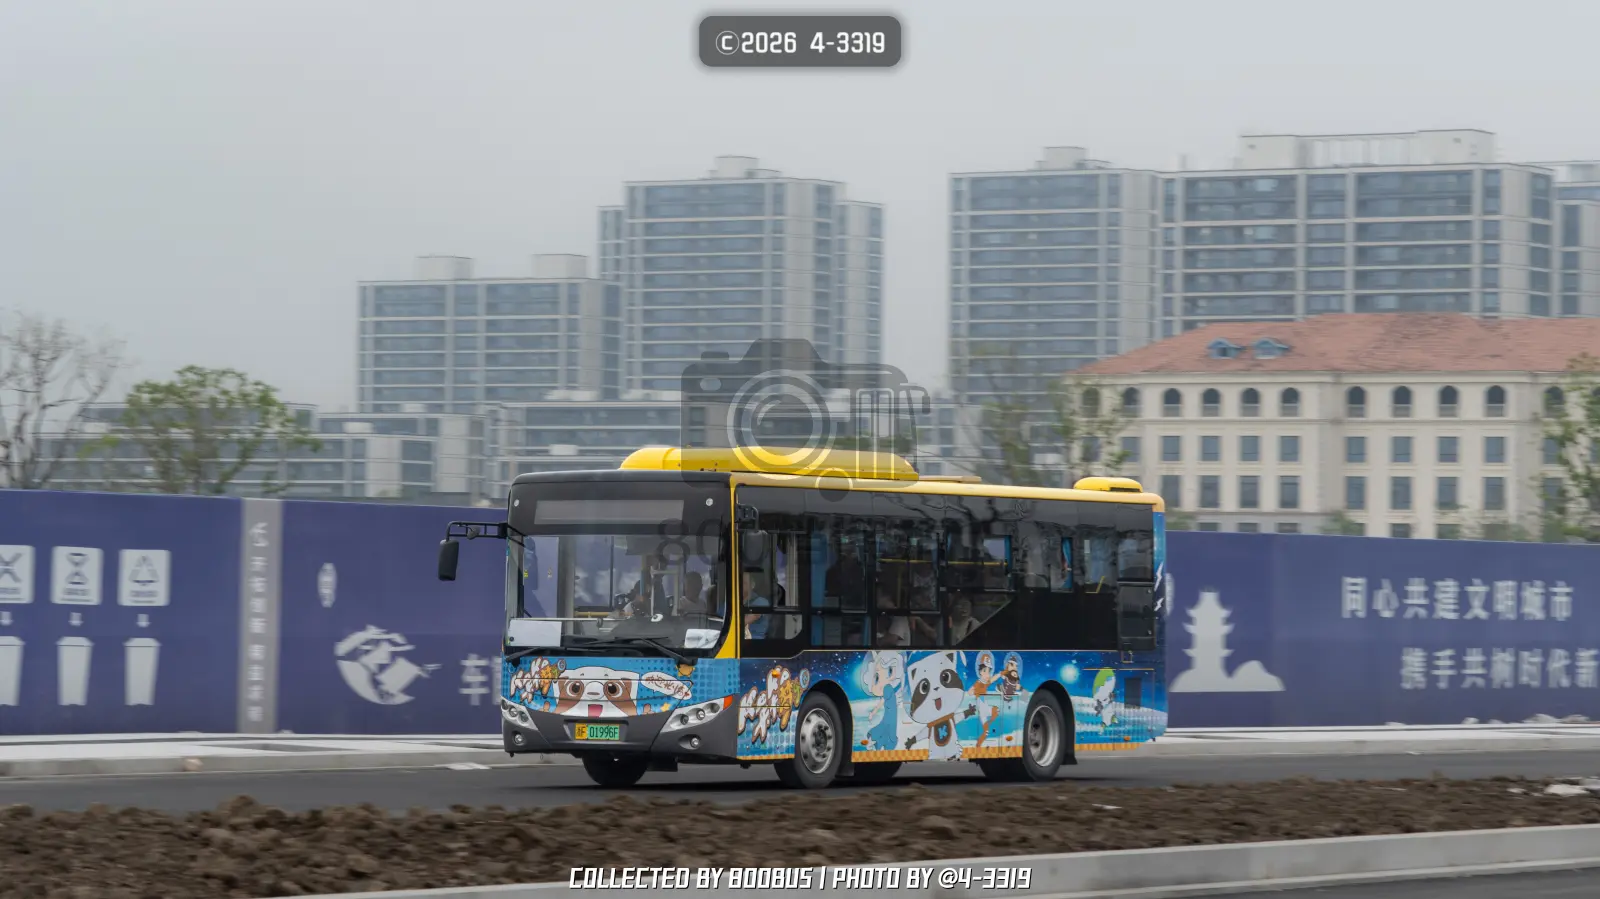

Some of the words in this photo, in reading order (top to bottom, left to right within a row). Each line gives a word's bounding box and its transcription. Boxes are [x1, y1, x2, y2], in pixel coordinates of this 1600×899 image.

[1341, 576, 1574, 621] 同心共建文明城市
